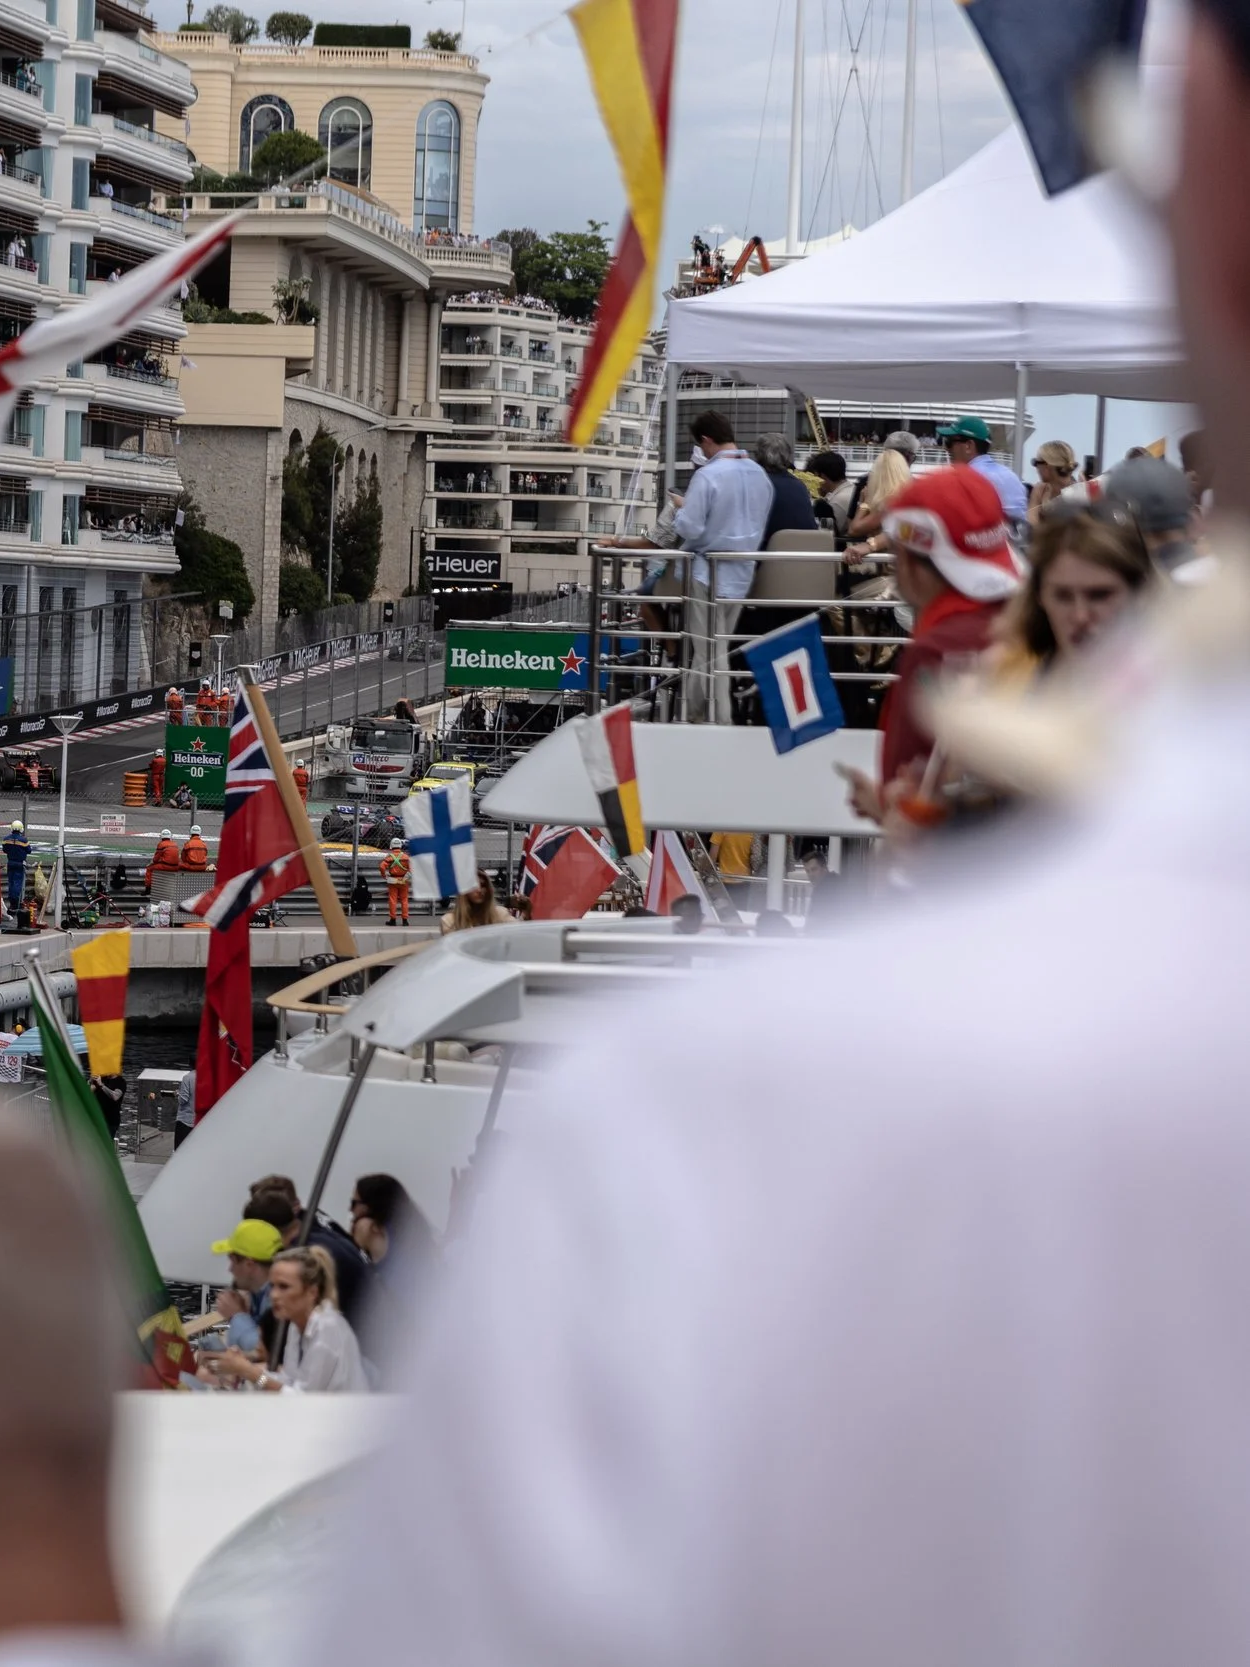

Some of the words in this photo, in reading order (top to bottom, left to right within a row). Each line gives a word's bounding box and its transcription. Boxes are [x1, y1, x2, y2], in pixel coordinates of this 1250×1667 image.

[424, 555, 498, 574] GHeuer
[450, 648, 556, 670] Heineken
[174, 753, 222, 765] Heineken
